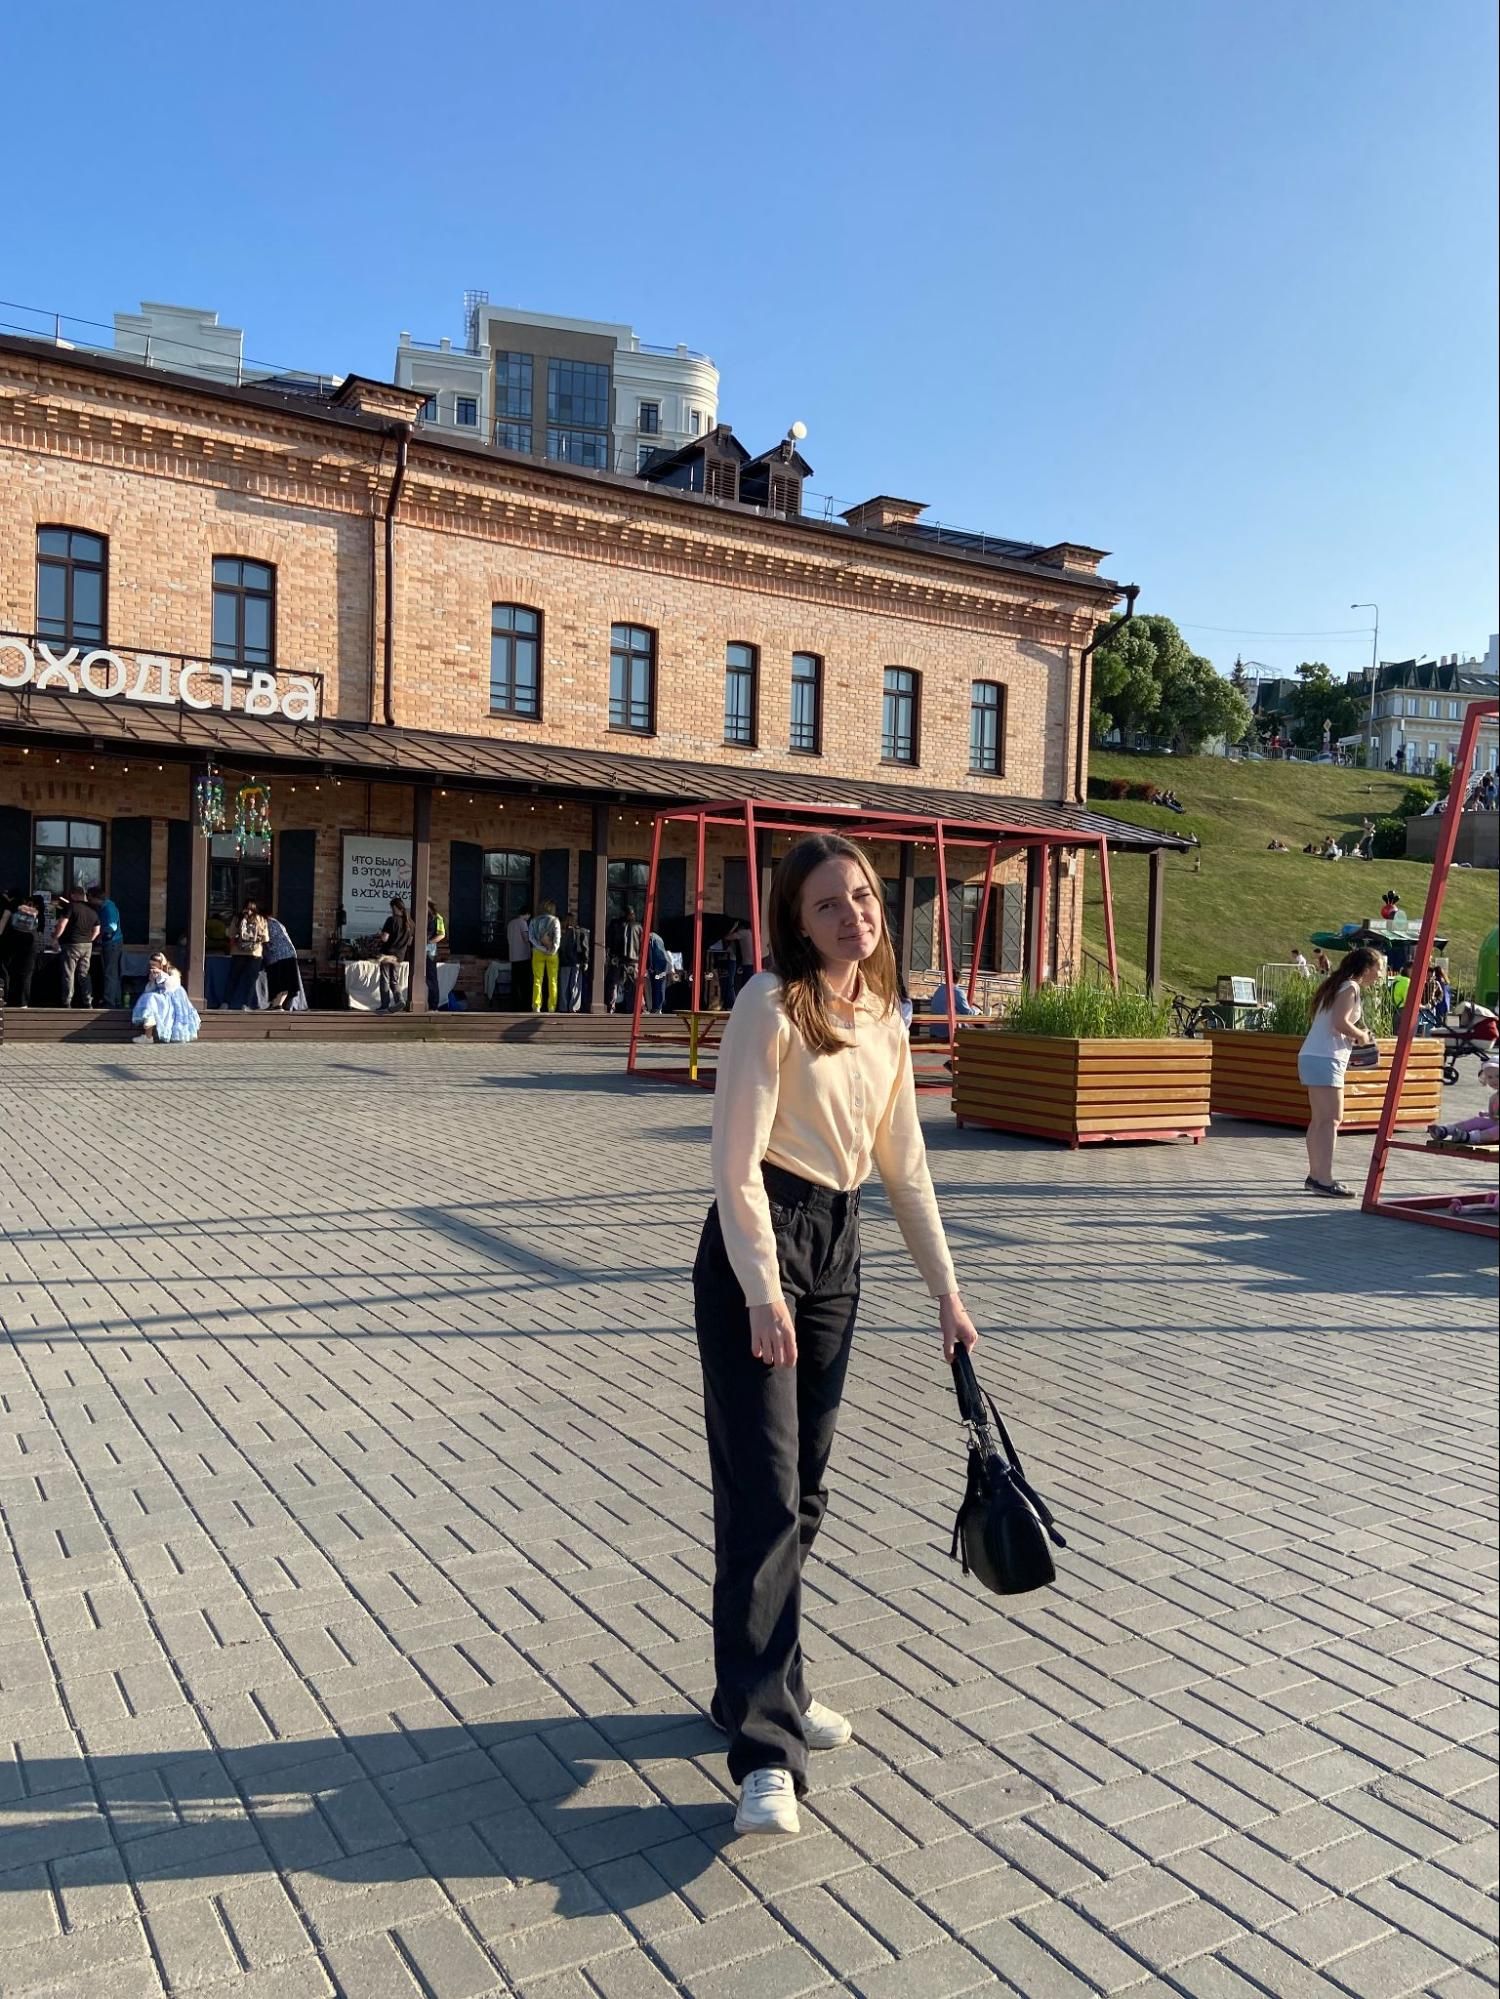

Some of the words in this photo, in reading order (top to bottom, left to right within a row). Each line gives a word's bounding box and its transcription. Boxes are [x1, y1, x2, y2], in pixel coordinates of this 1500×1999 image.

[352, 855, 373, 865] ЧТО
[375, 857, 406, 867] БЫЛО
[352, 866, 359, 875] В
[361, 867, 391, 877] ЭТОМ
[369, 879, 411, 889] ЗДАНИИ
[352, 888, 359, 897] В
